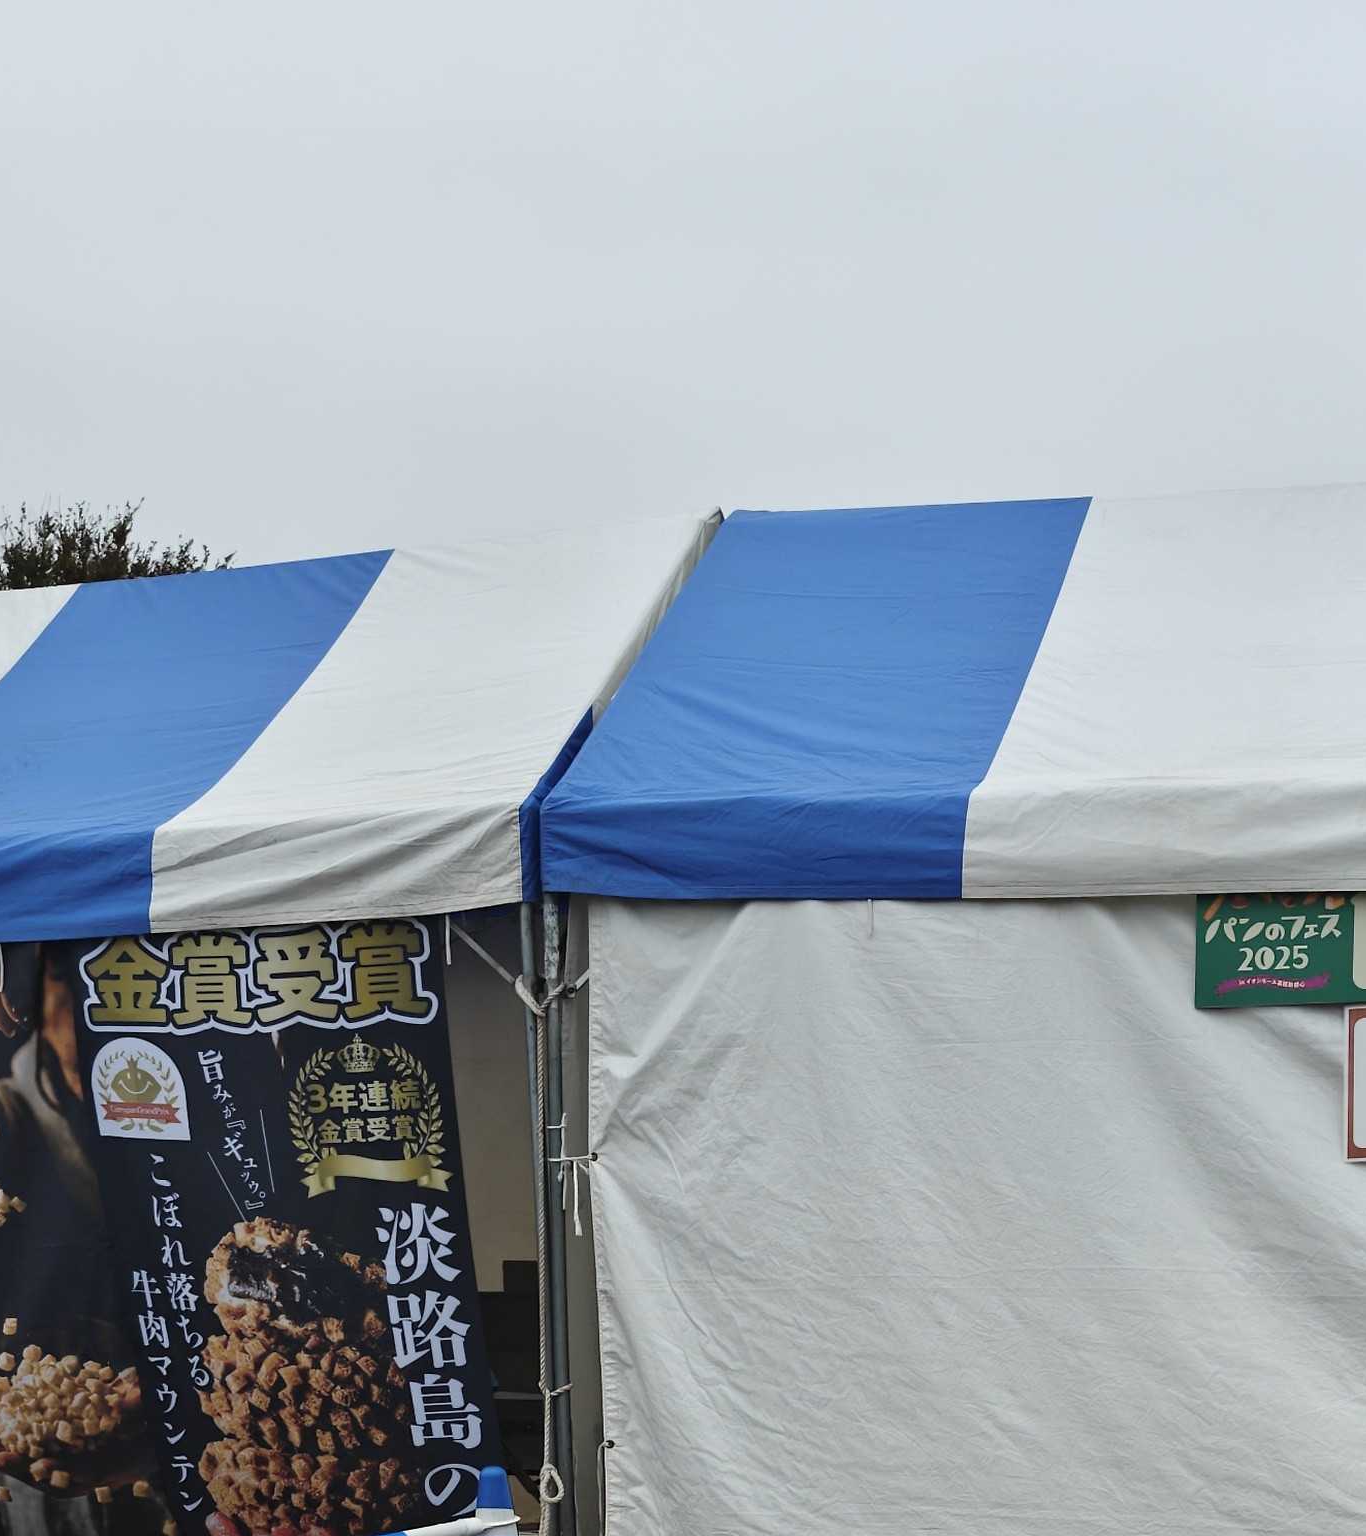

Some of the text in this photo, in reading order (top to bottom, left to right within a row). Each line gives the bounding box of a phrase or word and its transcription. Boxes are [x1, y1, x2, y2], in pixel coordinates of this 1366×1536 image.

[1205, 915, 1341, 942] パンのフェス
[85, 917, 434, 1028] 金賞受賞
[1238, 945, 1309, 970] 2025
[306, 1079, 422, 1113] 3年連続
[318, 1114, 416, 1143] 金賞受賞
[149, 1153, 209, 1387] こぼれ落ちる
[131, 1270, 203, 1512] 牛肉マウンテン
